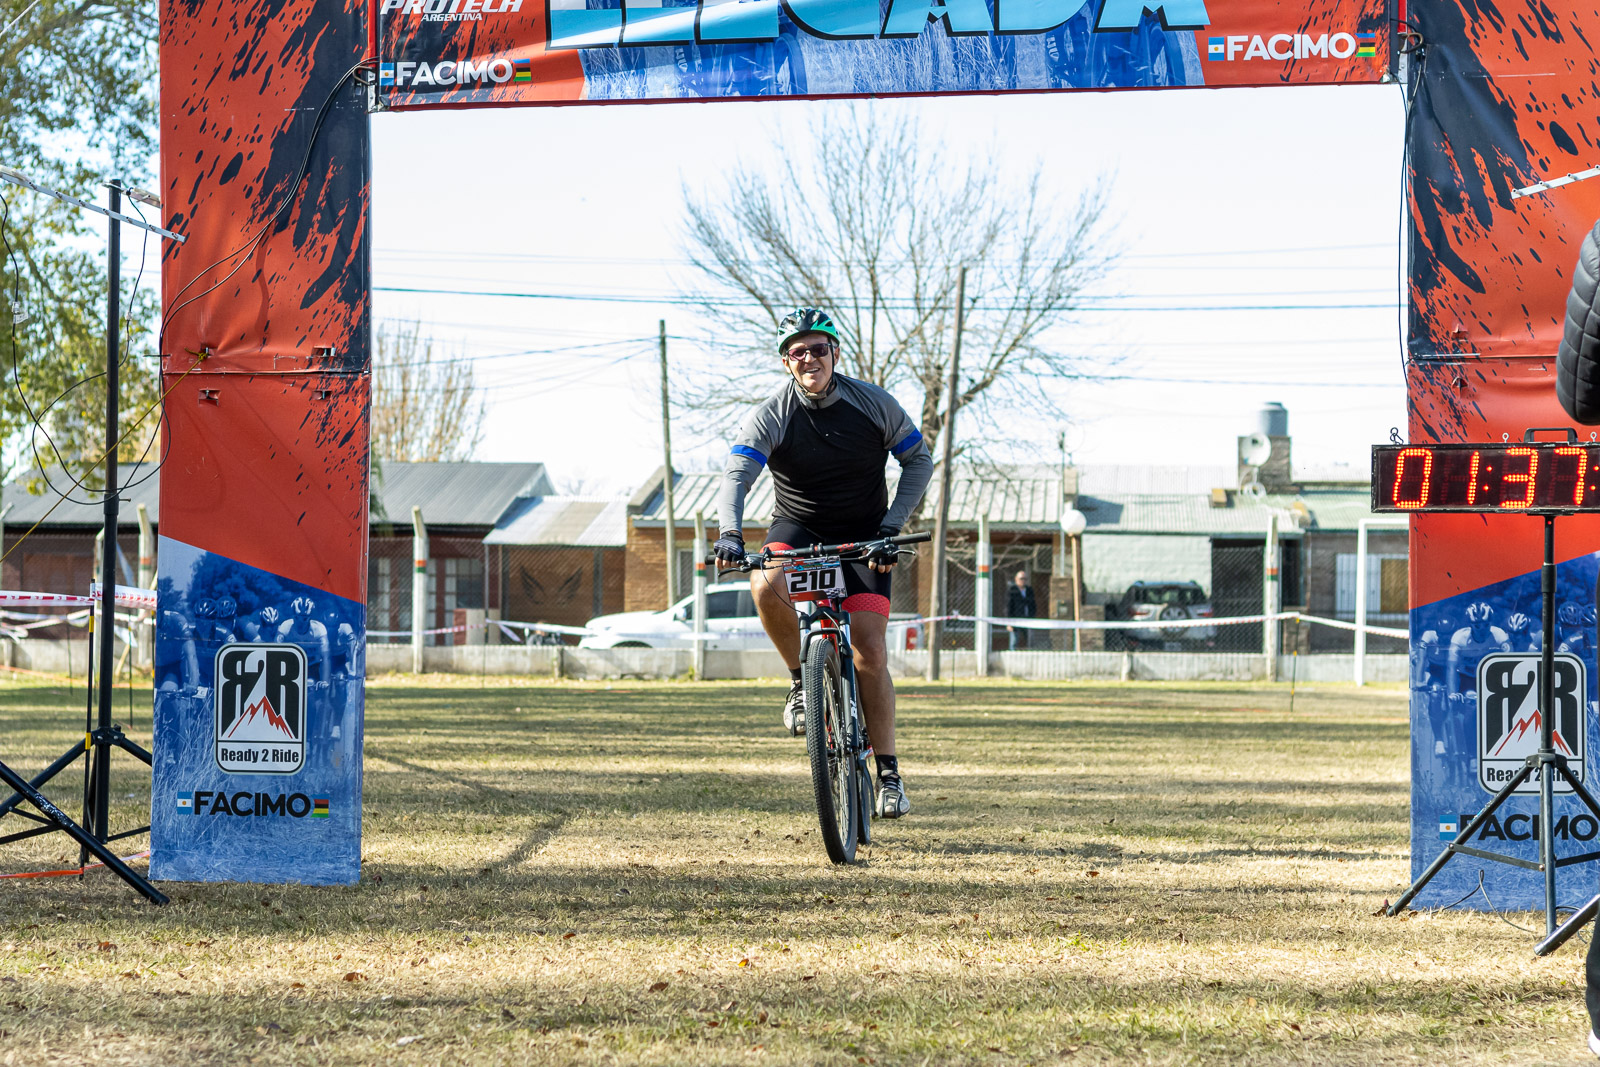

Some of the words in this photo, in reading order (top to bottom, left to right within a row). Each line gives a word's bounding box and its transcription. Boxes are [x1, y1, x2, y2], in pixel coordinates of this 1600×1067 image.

[421, 13, 483, 22] ARGENTINA
[1226, 32, 1357, 62] FACIMO
[396, 58, 513, 86] FACIMO
[791, 569, 836, 593] 210
[221, 748, 259, 763] Ready
[261, 749, 269, 762] 2
[272, 749, 299, 763] Ride
[194, 791, 312, 819] FACIMO
